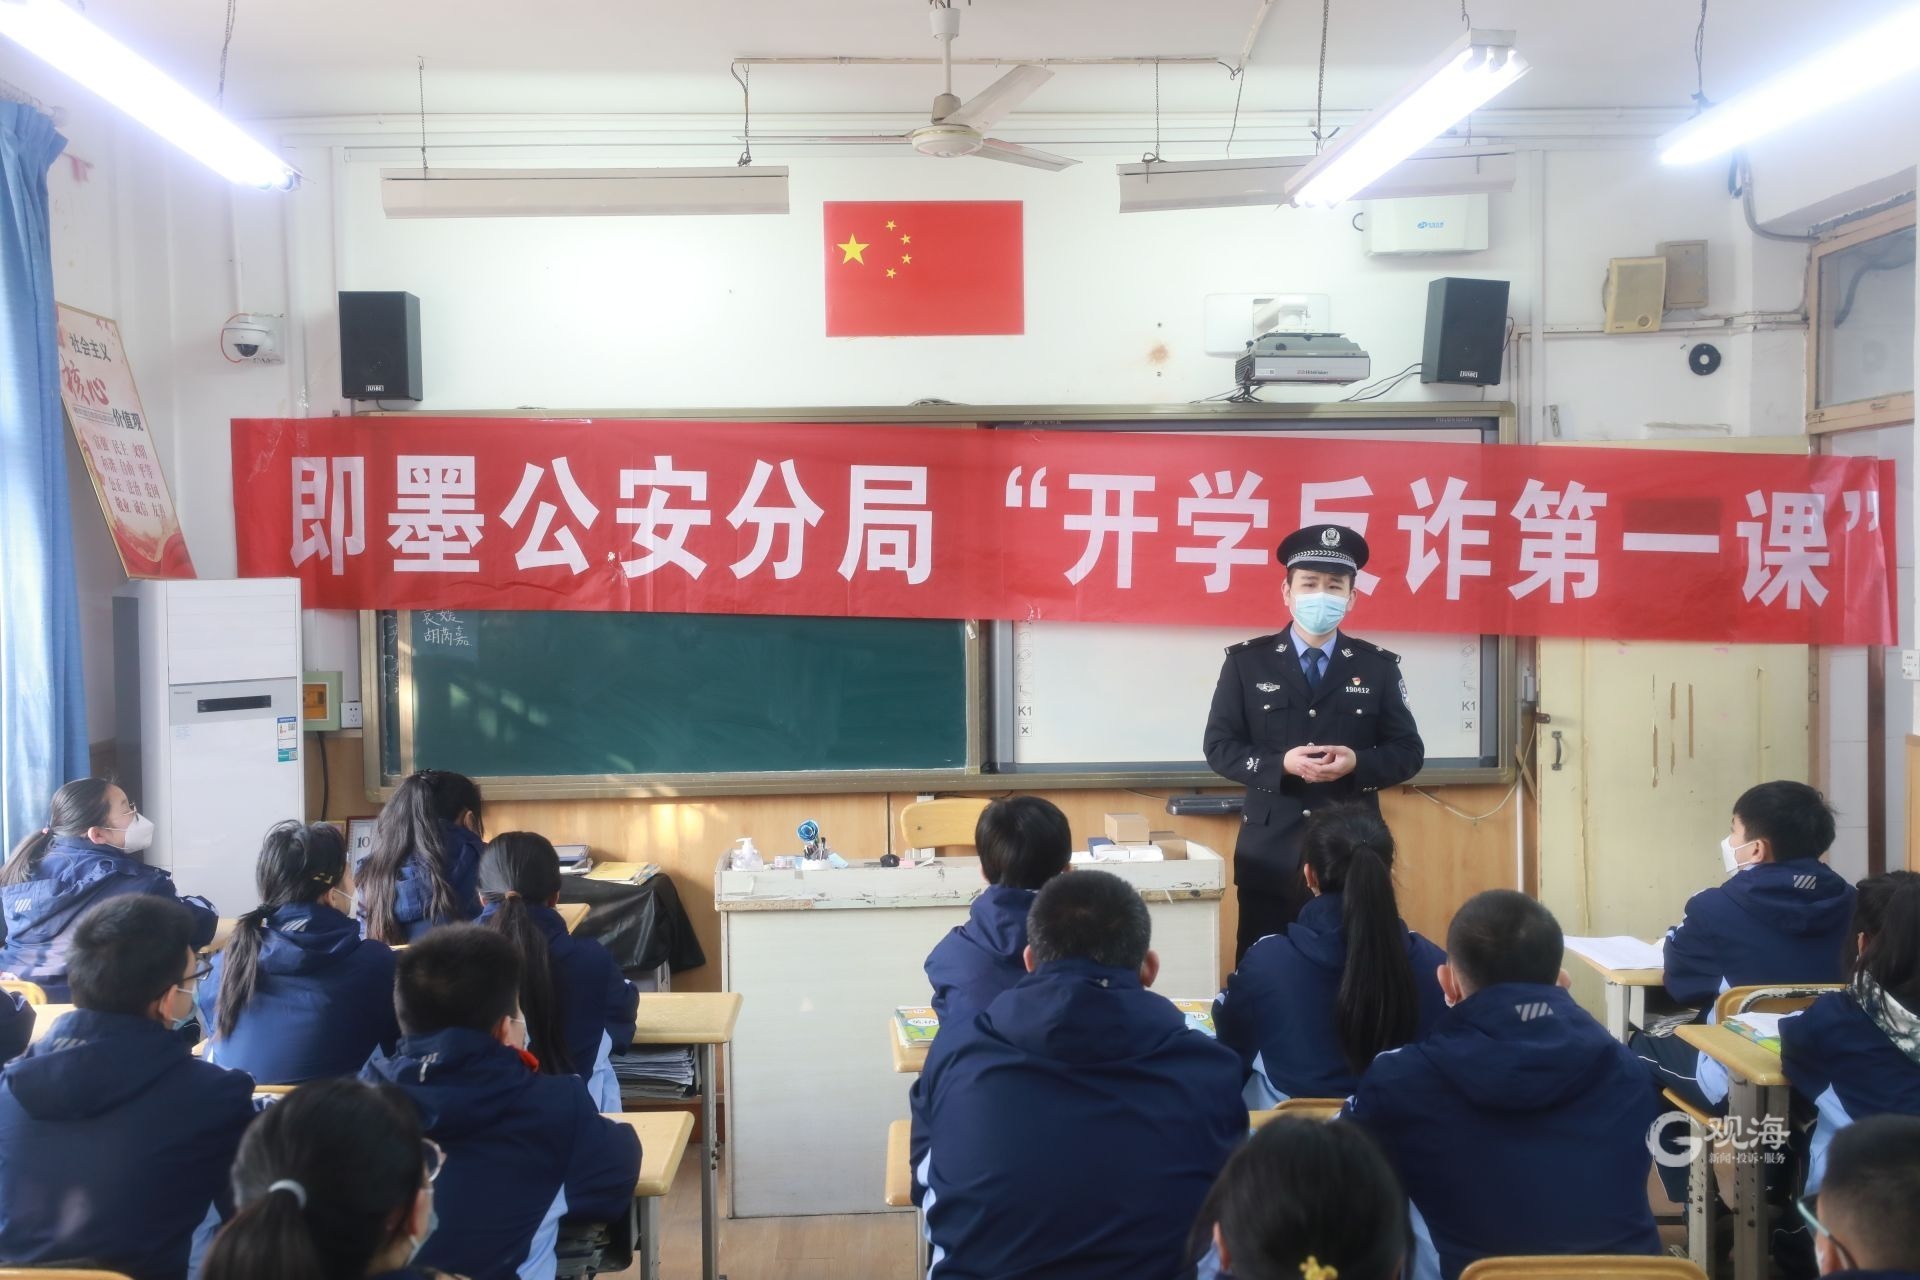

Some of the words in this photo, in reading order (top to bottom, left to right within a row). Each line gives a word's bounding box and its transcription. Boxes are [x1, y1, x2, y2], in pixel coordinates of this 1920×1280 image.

[69, 333, 112, 362] 社会主义
[112, 408, 144, 431] 价值观
[289, 455, 934, 586] 即墨公安分局
[1017, 705, 1032, 716] K1
[1462, 700, 1476, 711] K1
